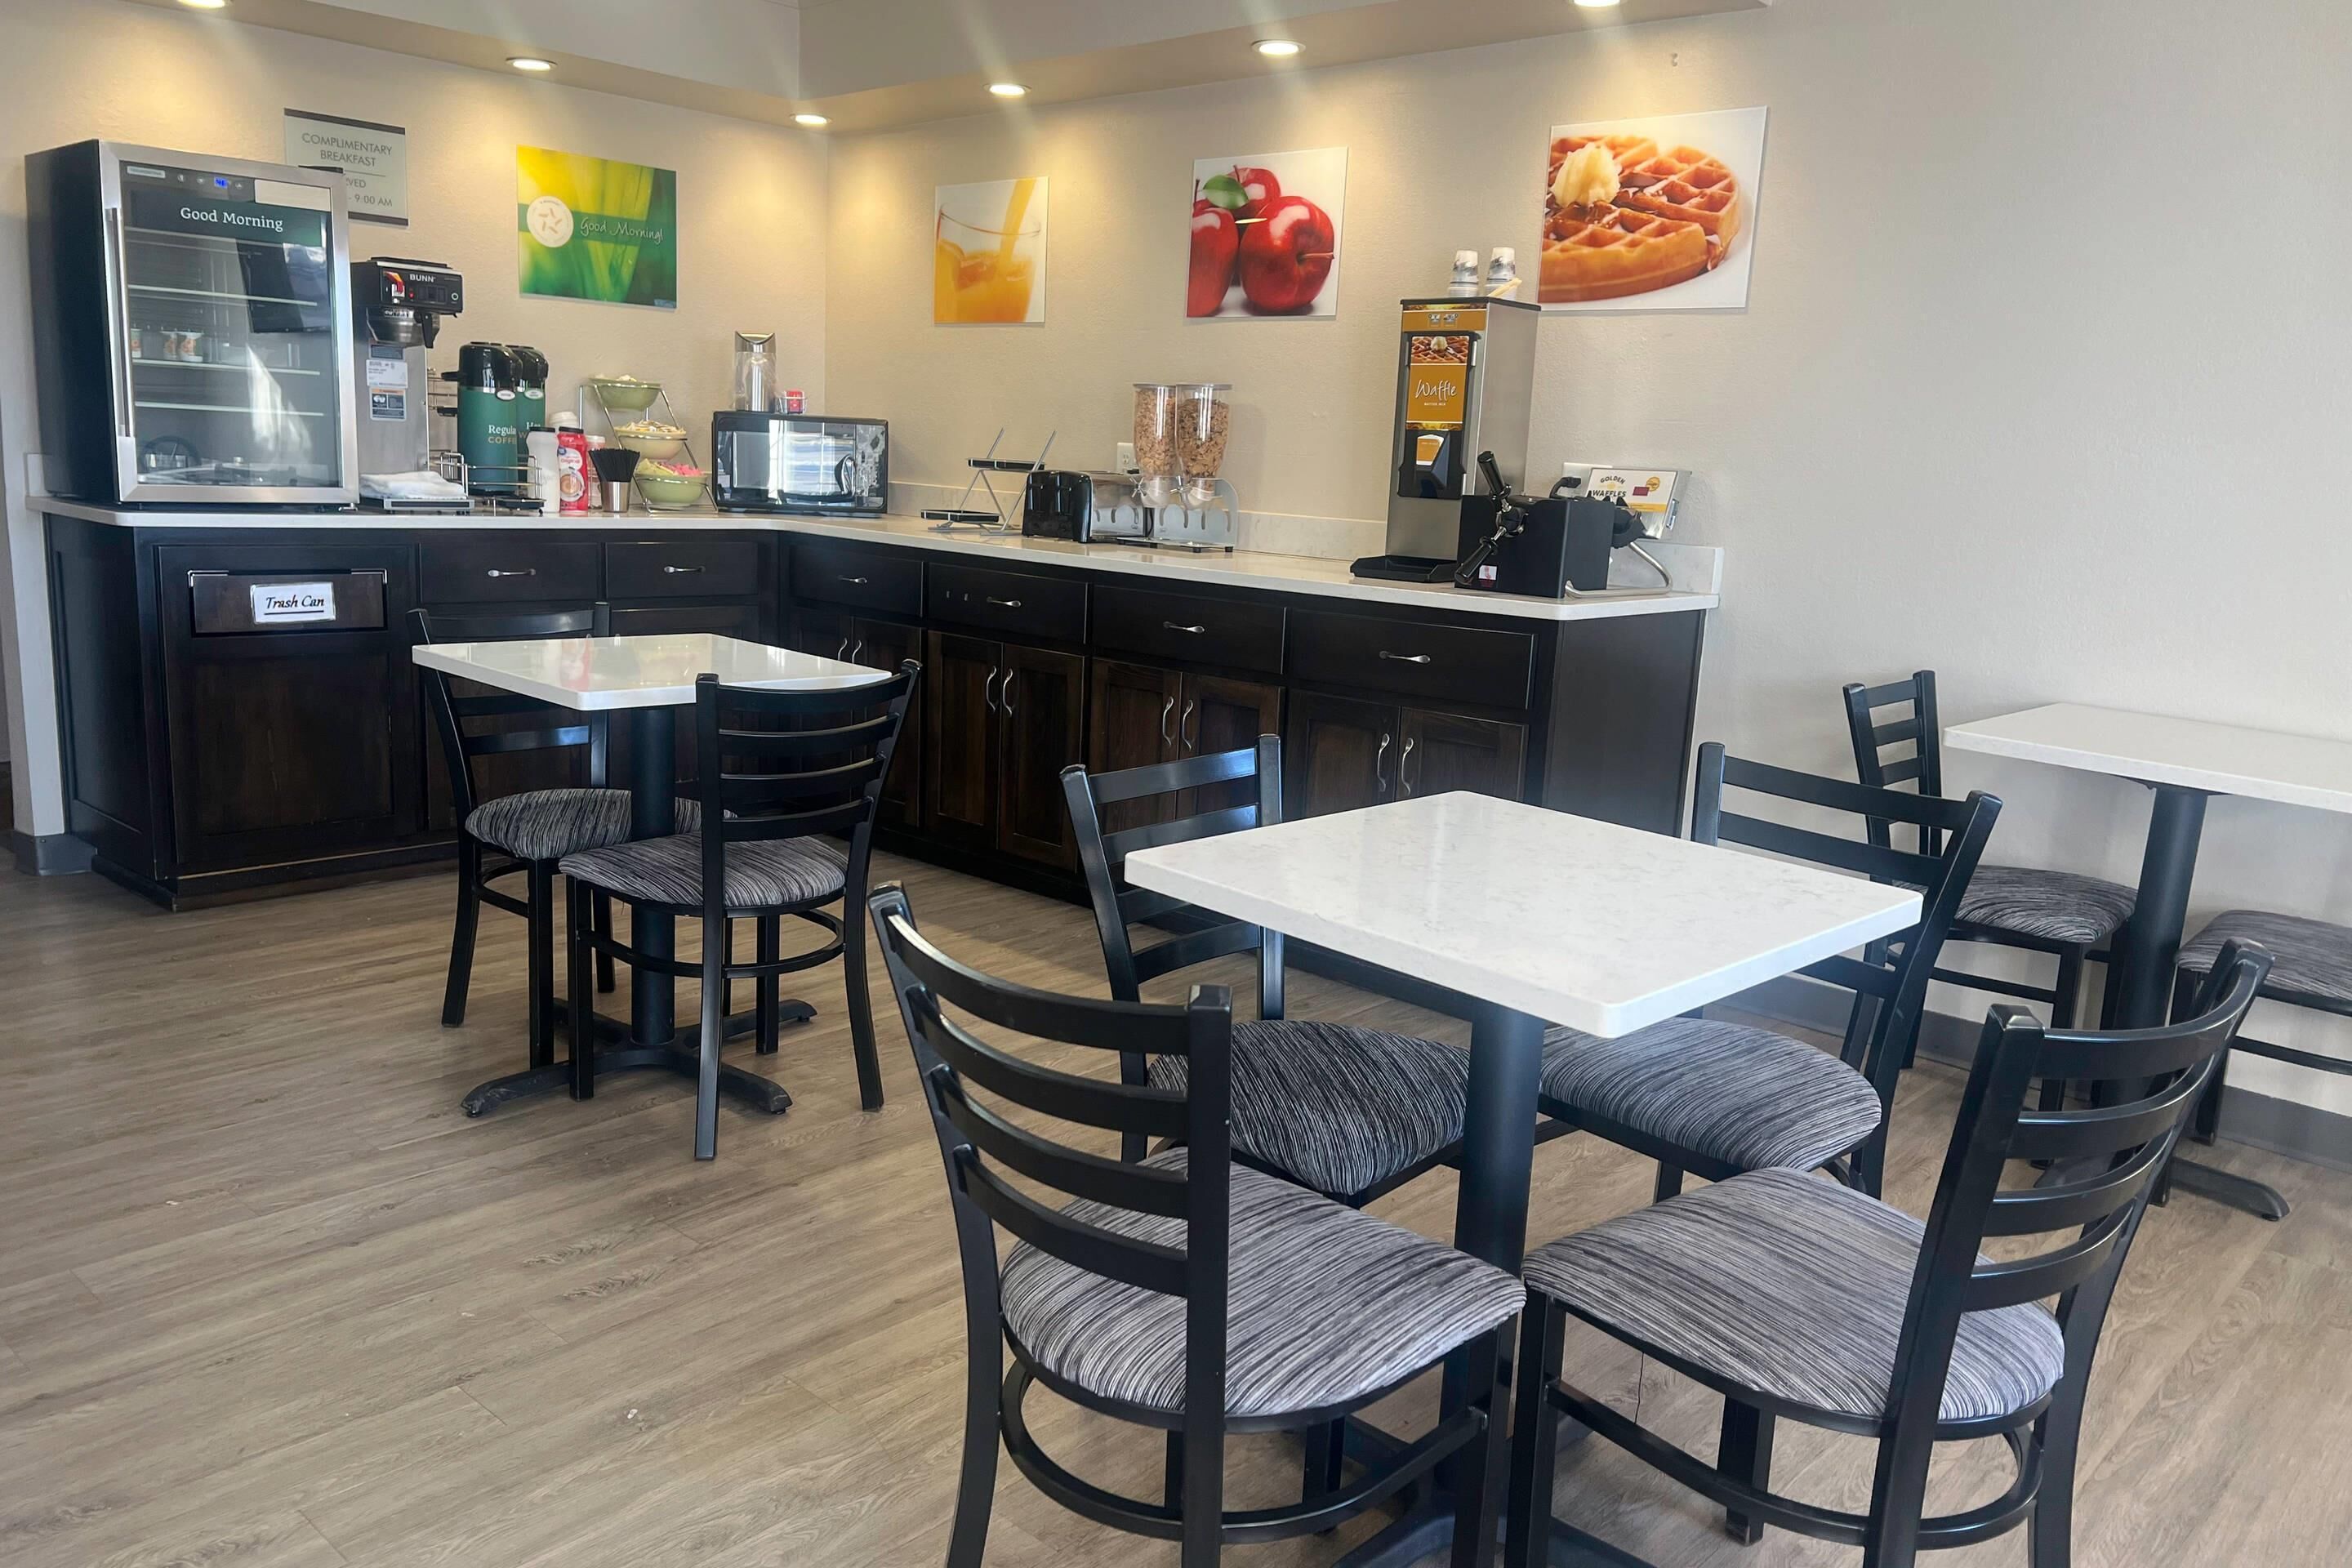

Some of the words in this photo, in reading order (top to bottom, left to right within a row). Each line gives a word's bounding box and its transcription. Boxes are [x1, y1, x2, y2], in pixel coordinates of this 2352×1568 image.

[301, 132, 393, 156] COMPLIMENTARY
[320, 149, 376, 167] BREAKFAST
[354, 194, 376, 205] 9:00
[378, 198, 393, 207] AM
[180, 207, 219, 223] Good
[222, 212, 283, 233] Morning
[581, 216, 607, 237] Good
[409, 274, 434, 283] BUNN
[1414, 378, 1458, 402] Waffle
[488, 424, 517, 437] Regula
[1600, 475, 1626, 484] GOLDEN
[1592, 489, 1627, 498] WAFFLES
[265, 594, 299, 609] Trash
[301, 595, 324, 608] Can
